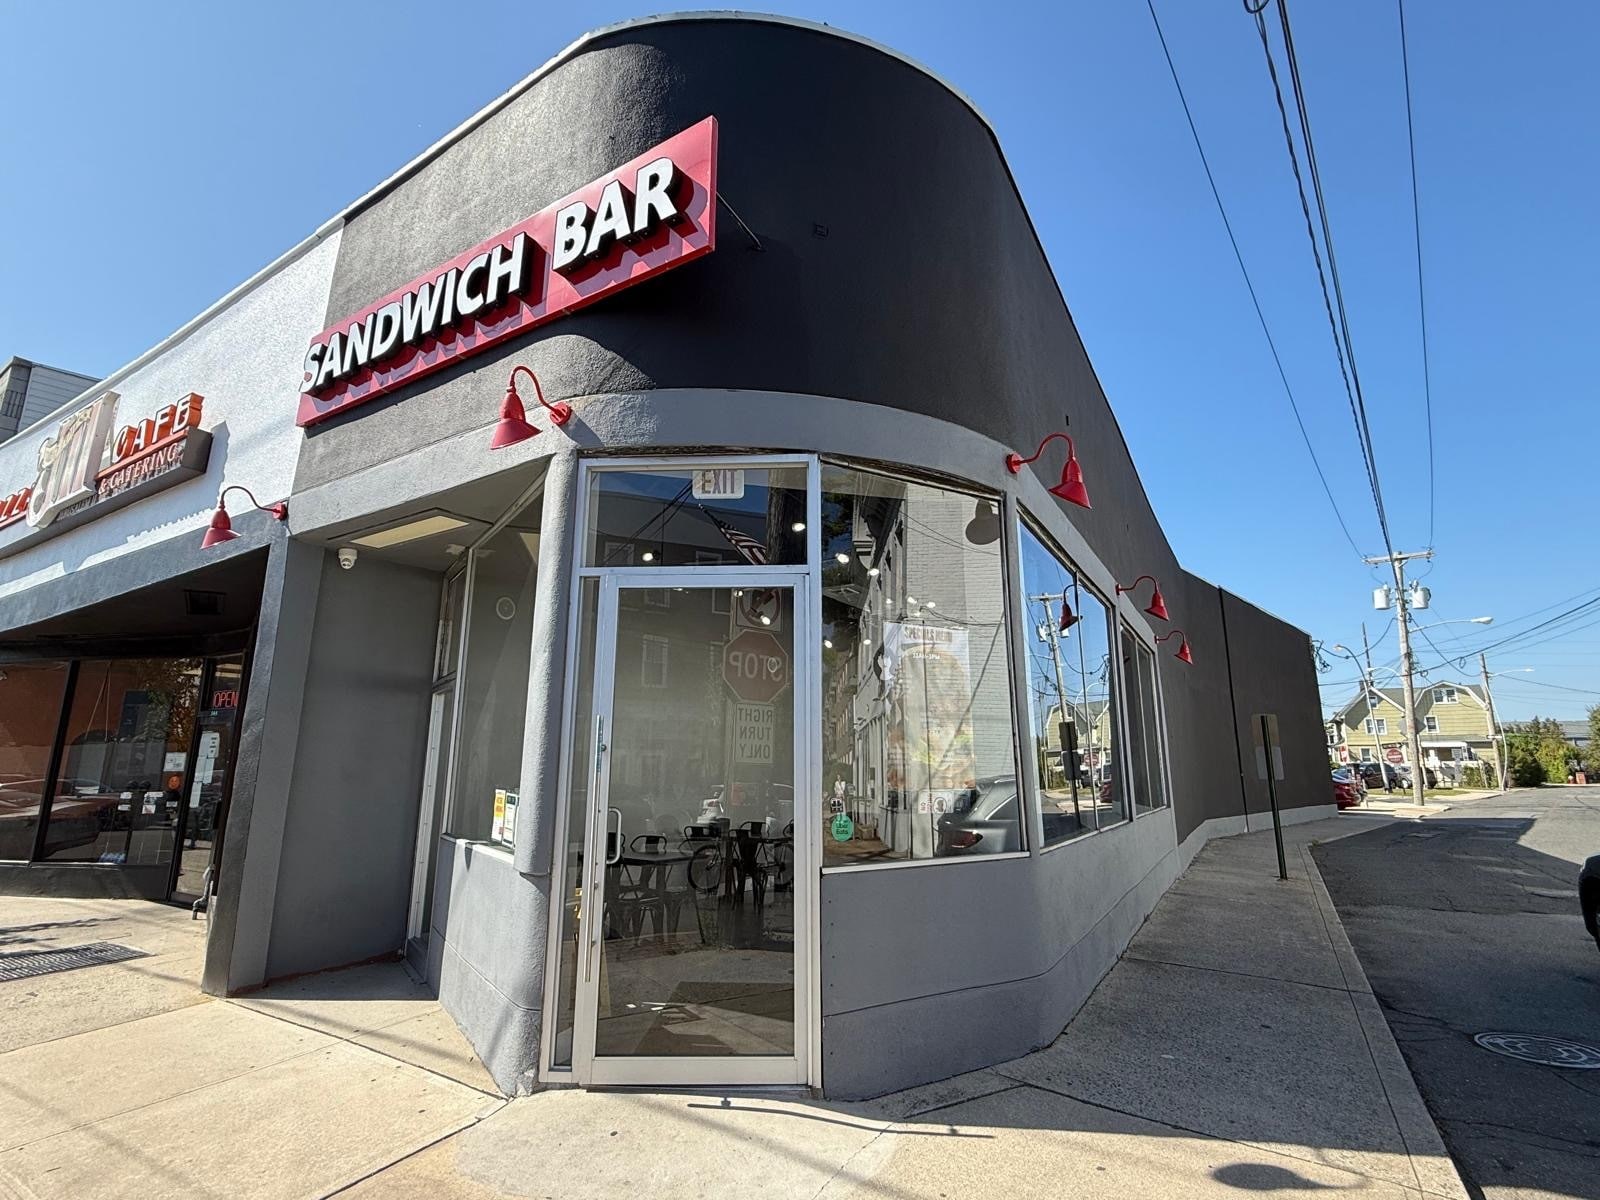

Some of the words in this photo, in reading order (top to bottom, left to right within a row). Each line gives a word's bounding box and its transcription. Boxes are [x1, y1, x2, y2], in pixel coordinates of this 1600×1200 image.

[299, 232, 528, 393] SANDWICH
[552, 157, 679, 271] BAR
[111, 393, 202, 465] CAFE
[110, 443, 178, 489] CATERING
[702, 469, 737, 494] EXIT
[214, 691, 238, 708] OPEN
